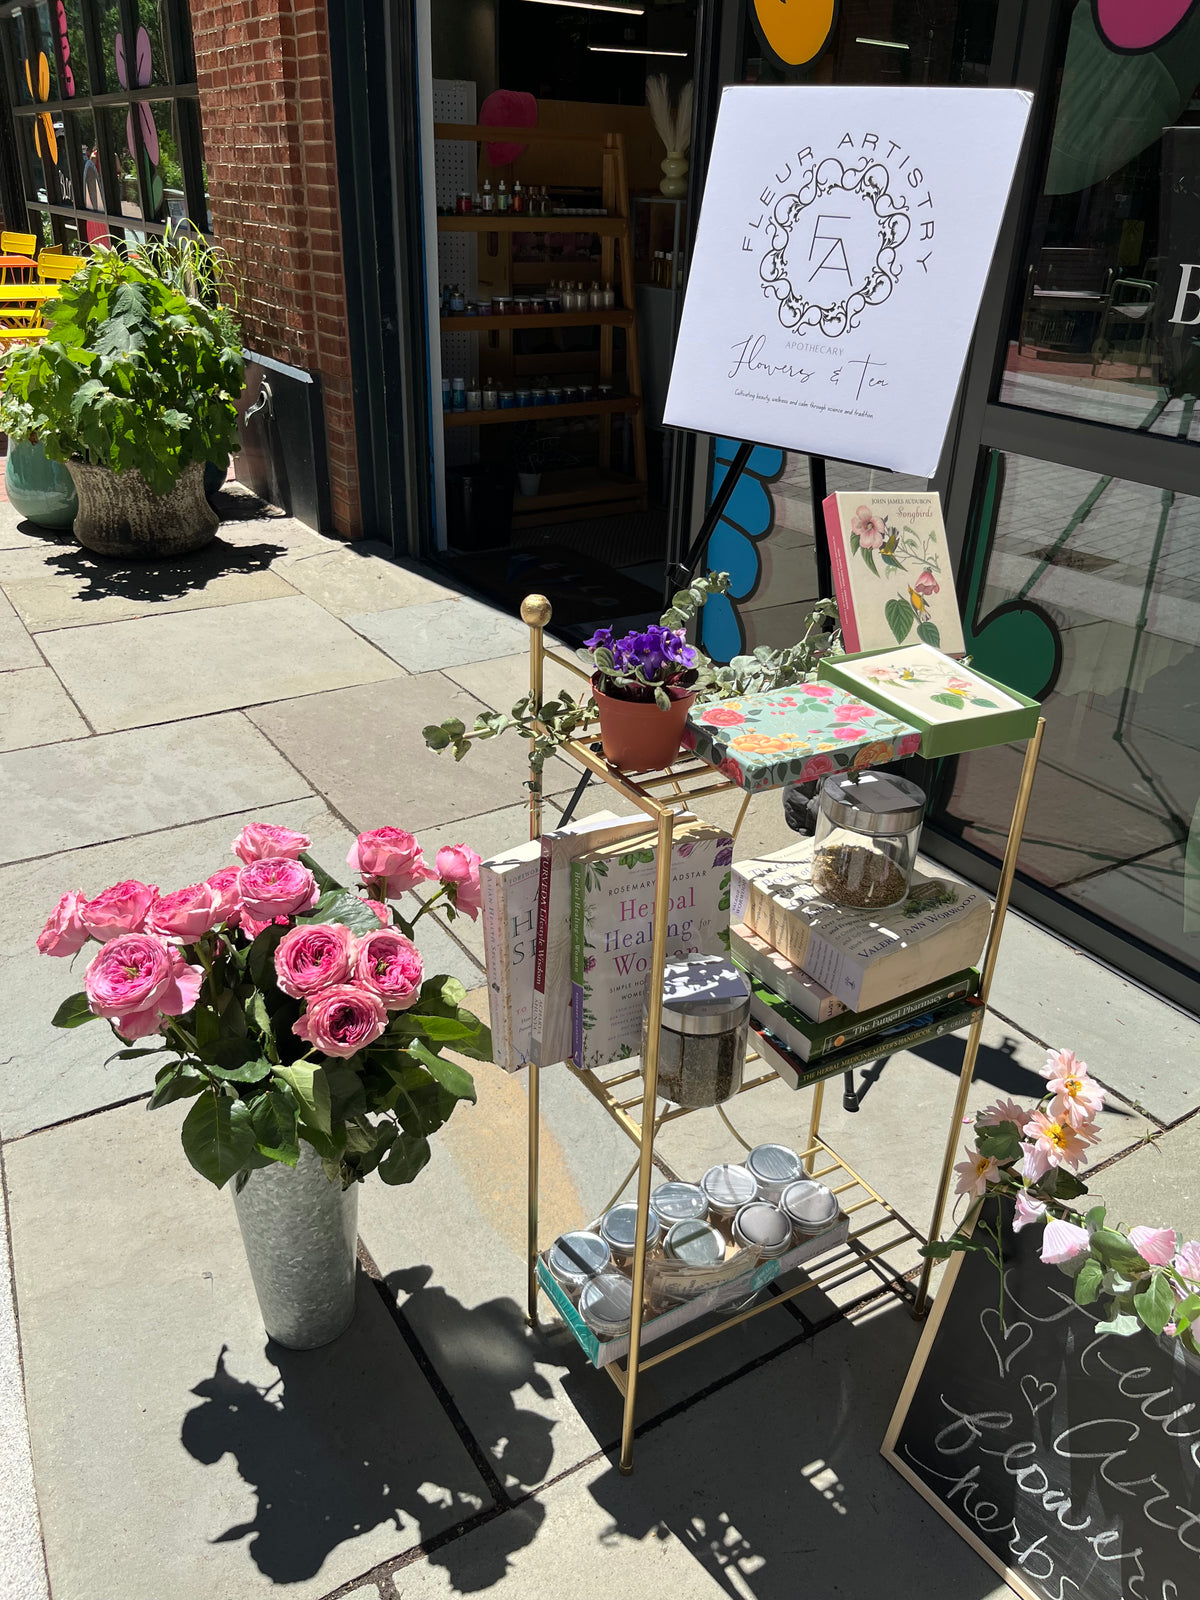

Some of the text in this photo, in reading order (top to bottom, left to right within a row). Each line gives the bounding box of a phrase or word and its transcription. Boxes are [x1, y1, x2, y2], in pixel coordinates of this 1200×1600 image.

[742, 132, 935, 273] FLEUR ARTISTRY
[785, 340, 845, 356] APOTHECARY
[728, 334, 889, 401] Flowers & Tea
[896, 505, 933, 524] Songbirds
[608, 880, 657, 897] ROSEMARY
[619, 886, 696, 922] Heal
[536, 845, 550, 985] AYURVEDA Lifestyle Wisdom
[573, 902, 581, 934] Healing
[902, 920, 927, 936] ANN
[924, 893, 977, 924] WORWOOD
[604, 919, 711, 953] Healng for
[610, 983, 632, 993] SIMPLE
[852, 994, 942, 1036] The Fungal Pharmacy
[803, 1073, 815, 1081] THE
[816, 1063, 840, 1076] HERBAL
[898, 1028, 932, 1045] HANDBOOK
